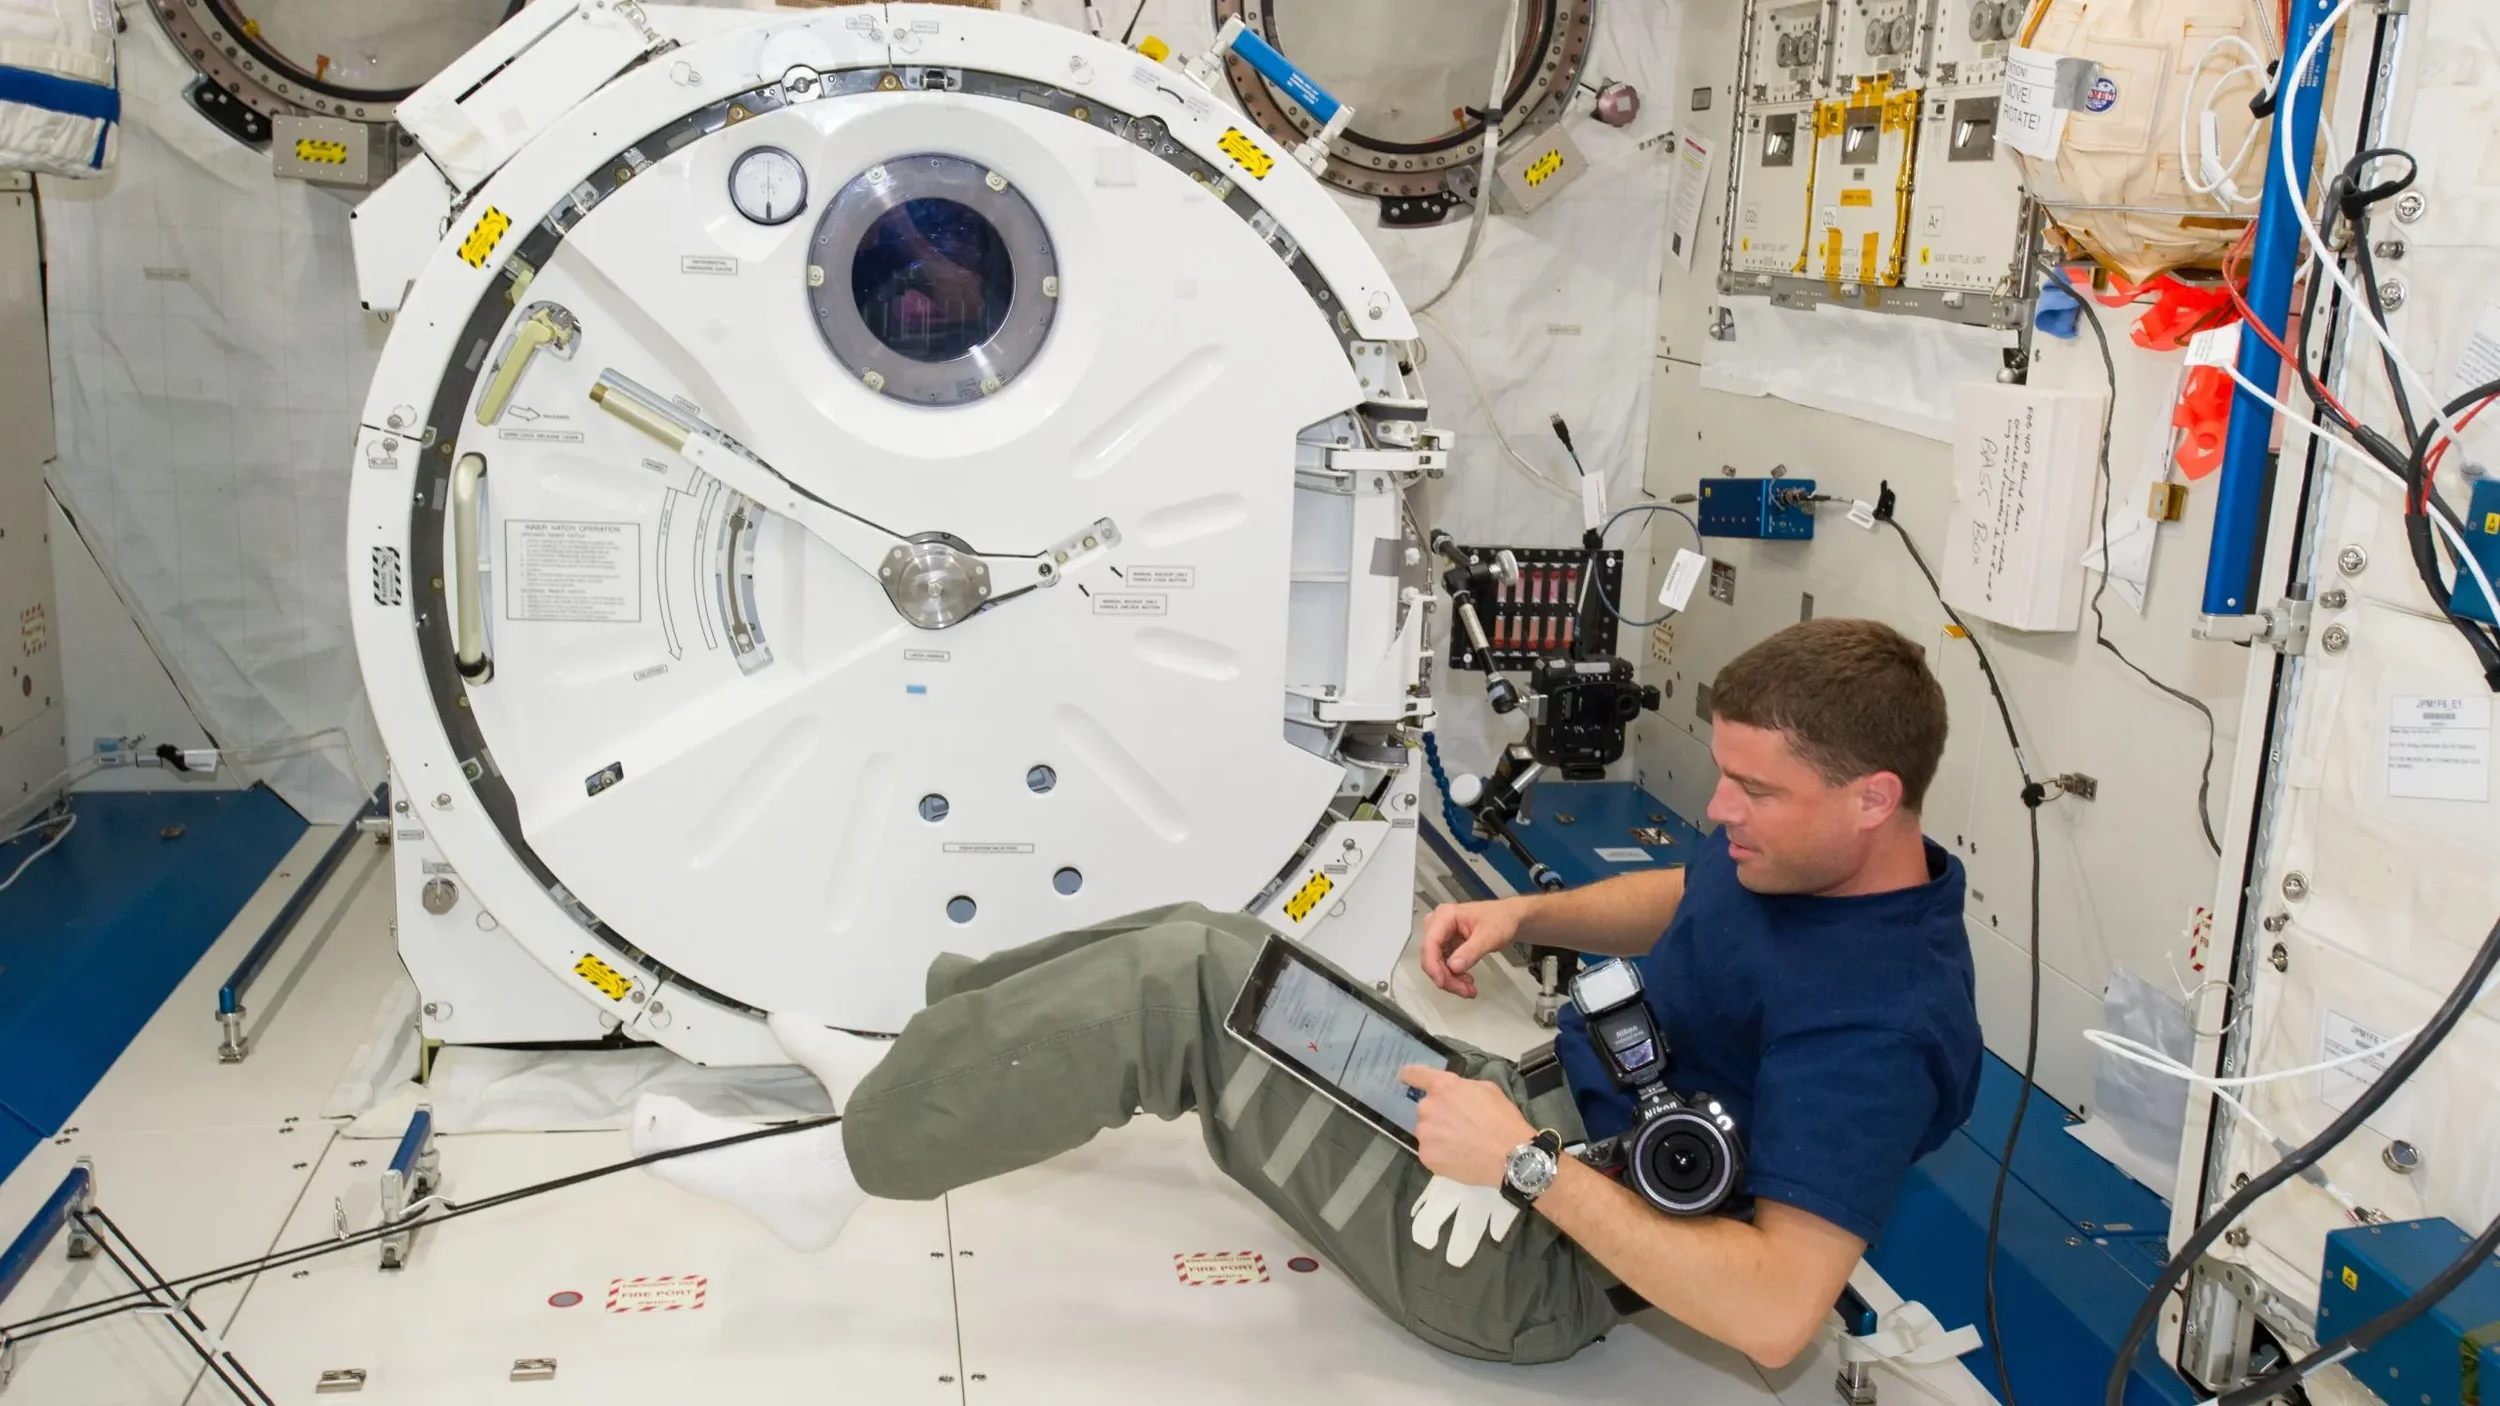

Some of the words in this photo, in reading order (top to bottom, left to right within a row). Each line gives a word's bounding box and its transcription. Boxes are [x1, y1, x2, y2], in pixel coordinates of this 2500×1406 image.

[1927, 213, 1940, 230] Ar
[1616, 1024, 1638, 1039] Nikon
[1644, 1100, 1678, 1120] Nikon
